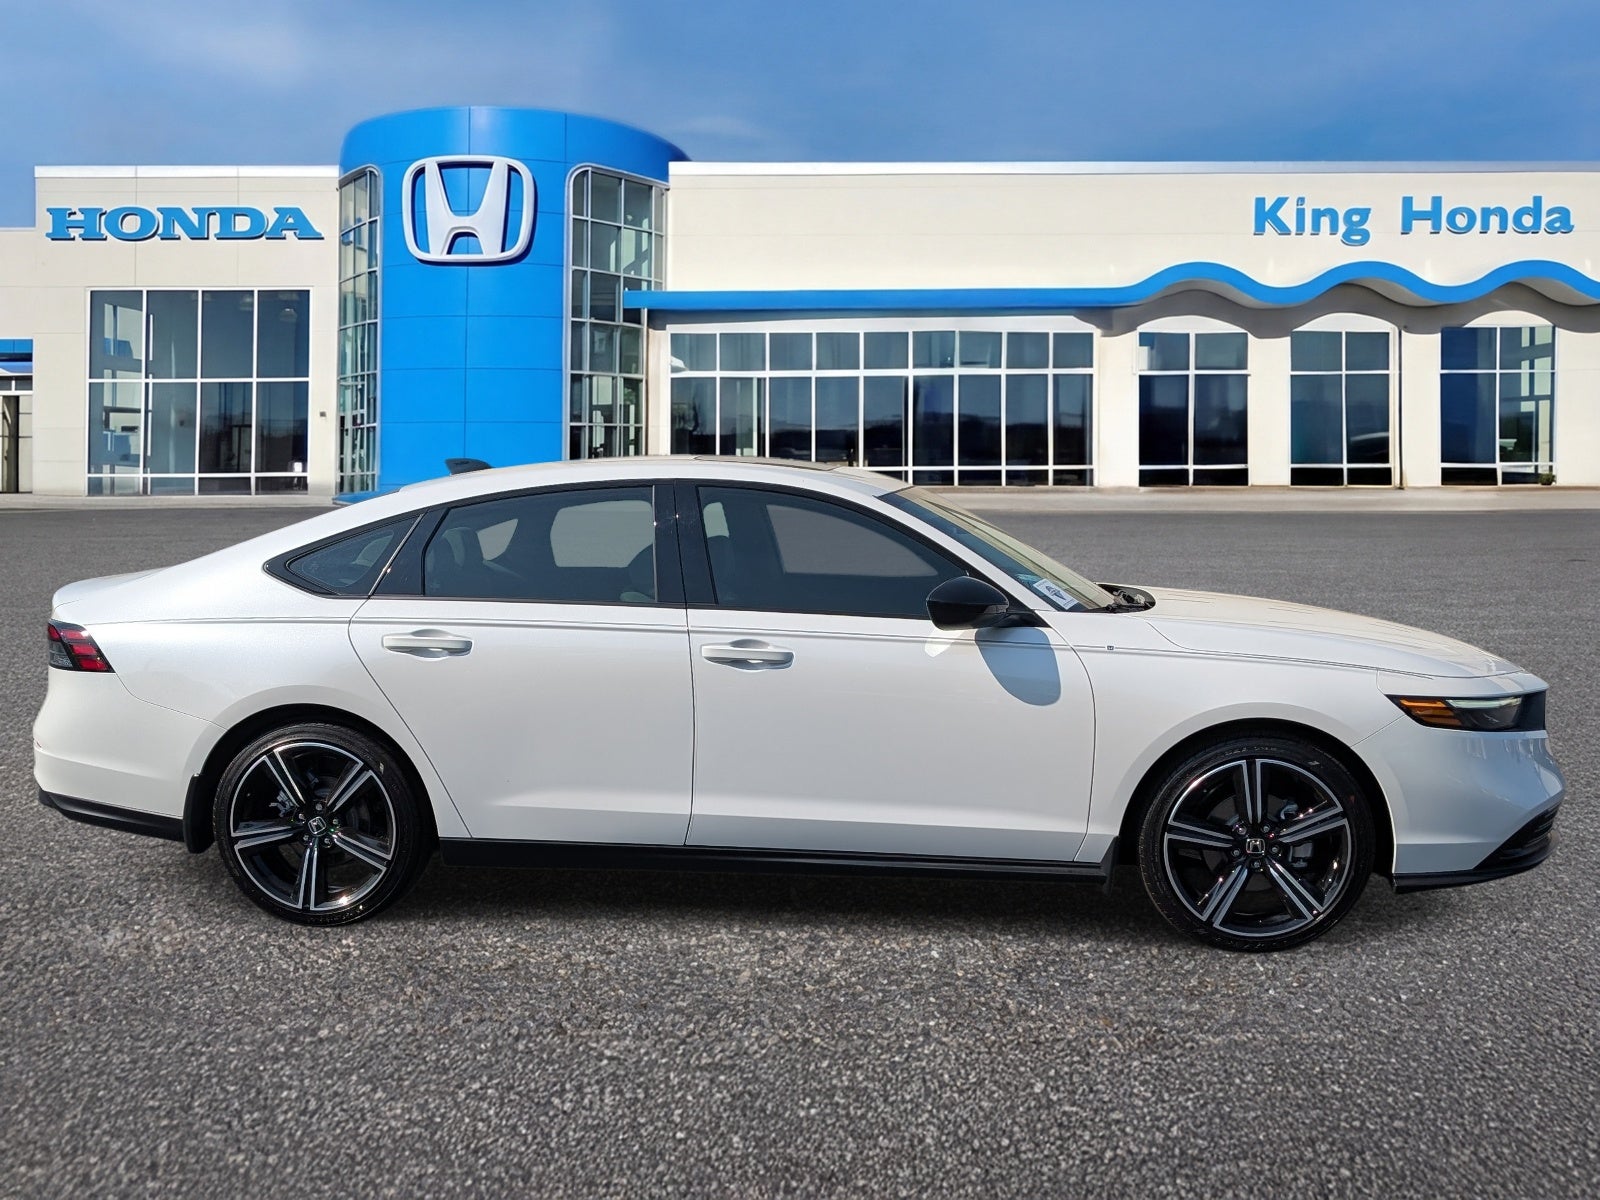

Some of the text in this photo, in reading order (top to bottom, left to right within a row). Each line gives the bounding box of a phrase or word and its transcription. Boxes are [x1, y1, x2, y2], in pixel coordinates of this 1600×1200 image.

[46, 206, 325, 241] HONDA
[1253, 195, 1575, 247] King Honda
